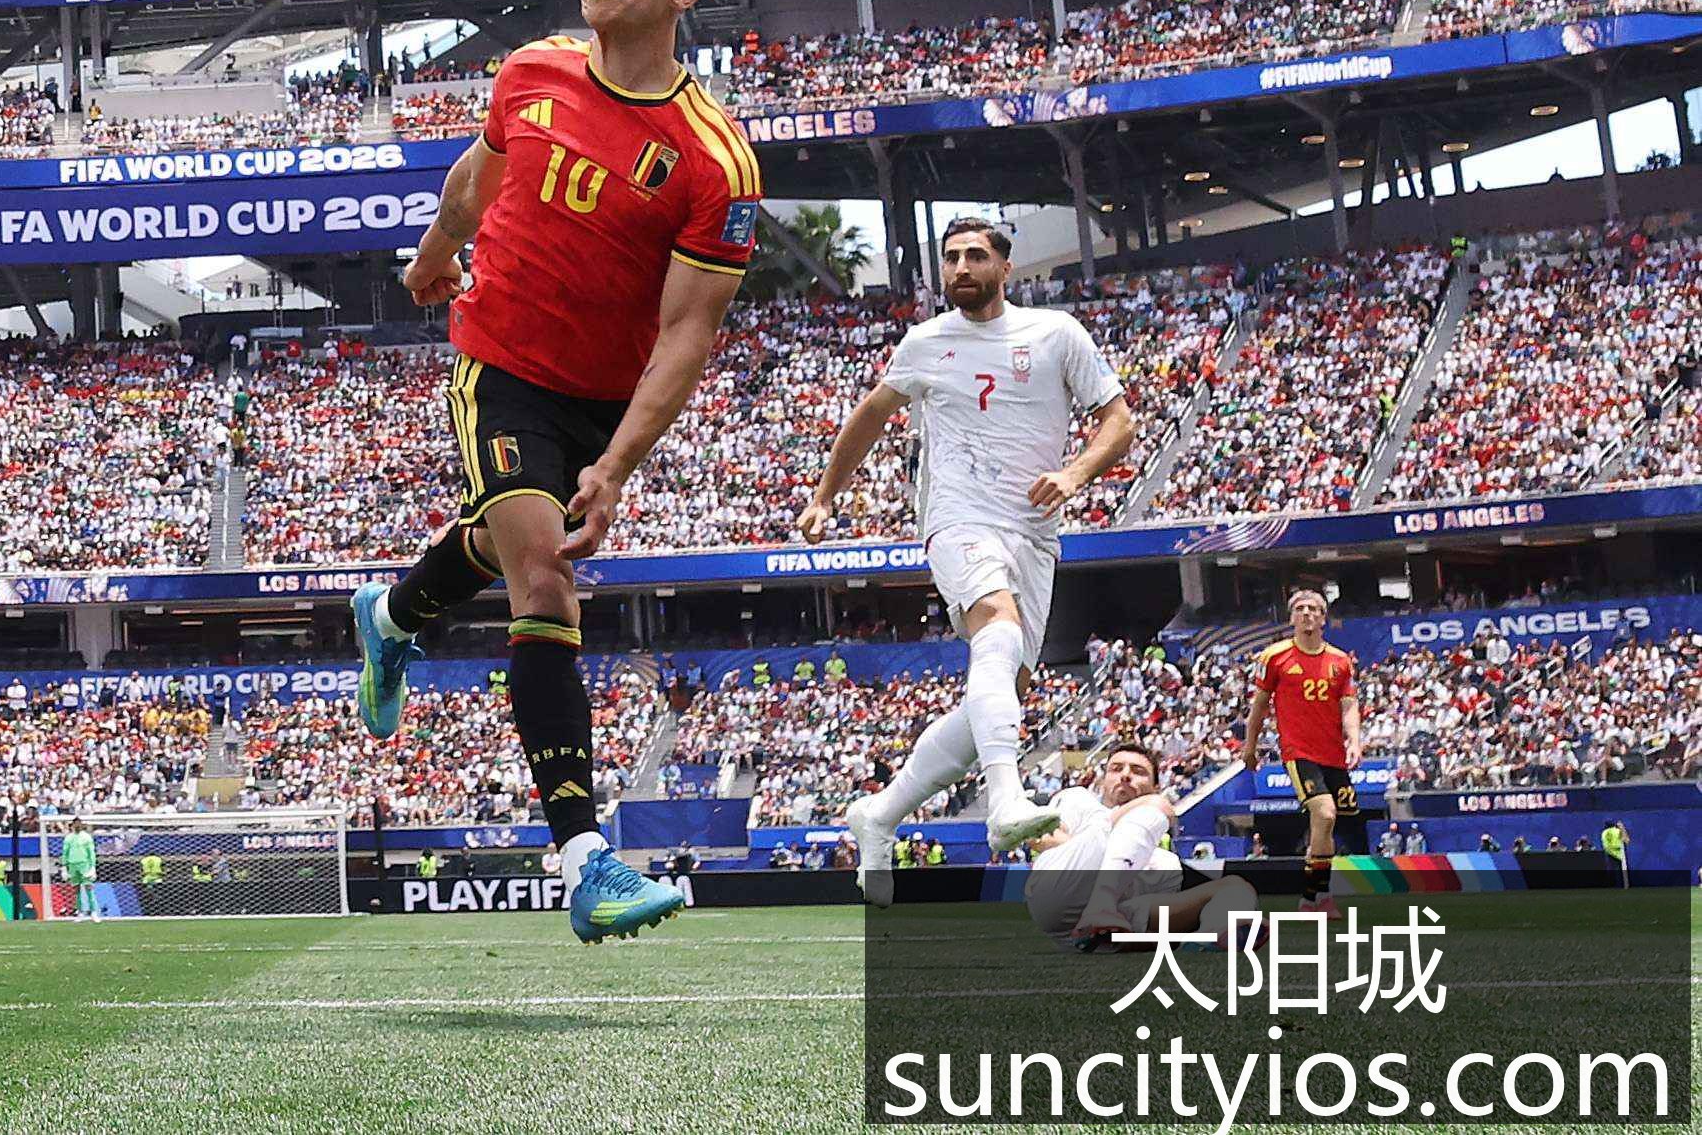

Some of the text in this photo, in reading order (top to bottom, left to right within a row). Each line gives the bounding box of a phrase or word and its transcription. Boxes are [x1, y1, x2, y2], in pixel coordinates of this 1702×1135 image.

[1259, 56, 1393, 90] #FIFAWorldCup
[59, 143, 405, 183] FIFA WORLD CUP 2026
[540, 143, 609, 213] 10
[57, 203, 222, 241] WORLD
[227, 198, 316, 236] CUP
[323, 191, 440, 231] 202
[974, 373, 996, 411] 7
[1394, 502, 1545, 534] LOS ANGELES
[766, 553, 812, 573] FIFA
[812, 549, 887, 571] WORLD
[258, 574, 300, 593] LOS
[1391, 619, 1465, 644] LOS
[290, 670, 360, 692] 202
[1302, 678, 1329, 701] 22
[1458, 794, 1491, 812] LOS
